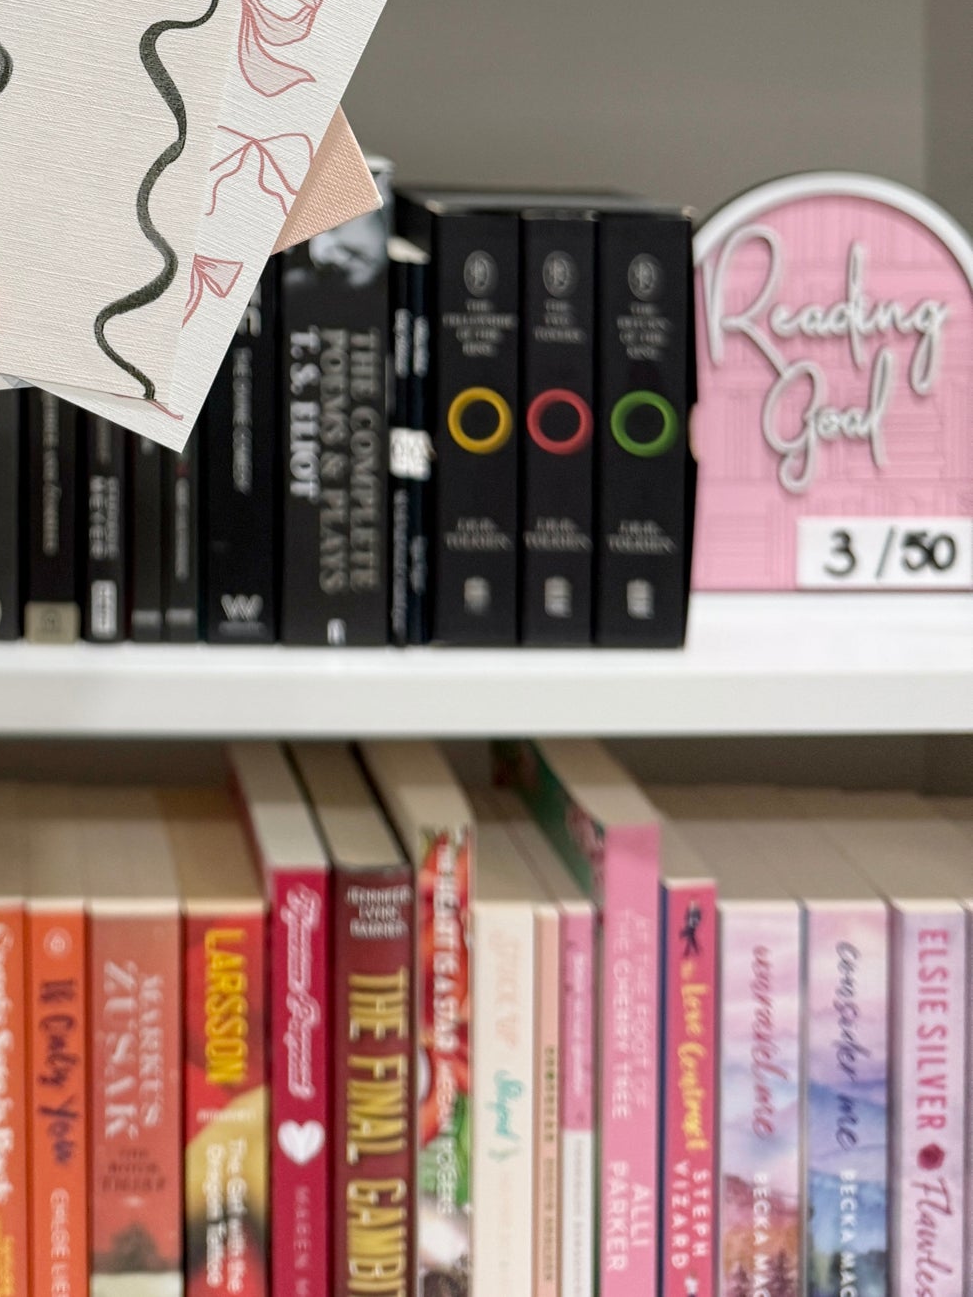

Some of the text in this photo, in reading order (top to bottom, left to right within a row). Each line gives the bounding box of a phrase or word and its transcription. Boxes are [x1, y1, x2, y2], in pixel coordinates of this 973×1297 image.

[702, 223, 949, 396] Reading
[289, 325, 321, 504] T. S. ELIOT
[319, 328, 349, 594] POEMS & PLAYS
[350, 328, 381, 593] THE COMPLETE
[761, 344, 895, 493] Goal
[38, 978, 77, 1005] If
[204, 927, 248, 1085] LARSSON
[347, 967, 408, 1041] THE
[433, 995, 459, 1052] STAR
[750, 946, 788, 1080] unravel
[917, 927, 951, 1015] ELSIE
[37, 1014, 79, 1088] Only
[102, 959, 140, 1141] ZUSAK
[139, 973, 165, 1129] MARKUS
[612, 1061, 630, 1120] TREE
[677, 983, 710, 1152] Love Contract
[833, 943, 870, 1243] consider me BECKA
[915, 1024, 949, 1131] SILVER
[38, 1095, 81, 1165] You
[346, 1054, 408, 1165] FINAL
[752, 1080, 775, 1140] me
[227, 1138, 247, 1294] The Girl with the
[606, 1159, 629, 1271] PARKER
[631, 1183, 651, 1247] ALLI
[671, 1159, 687, 1270] VIZARD
[693, 1168, 710, 1259] STEPH
[752, 1172, 770, 1245] BECKA
